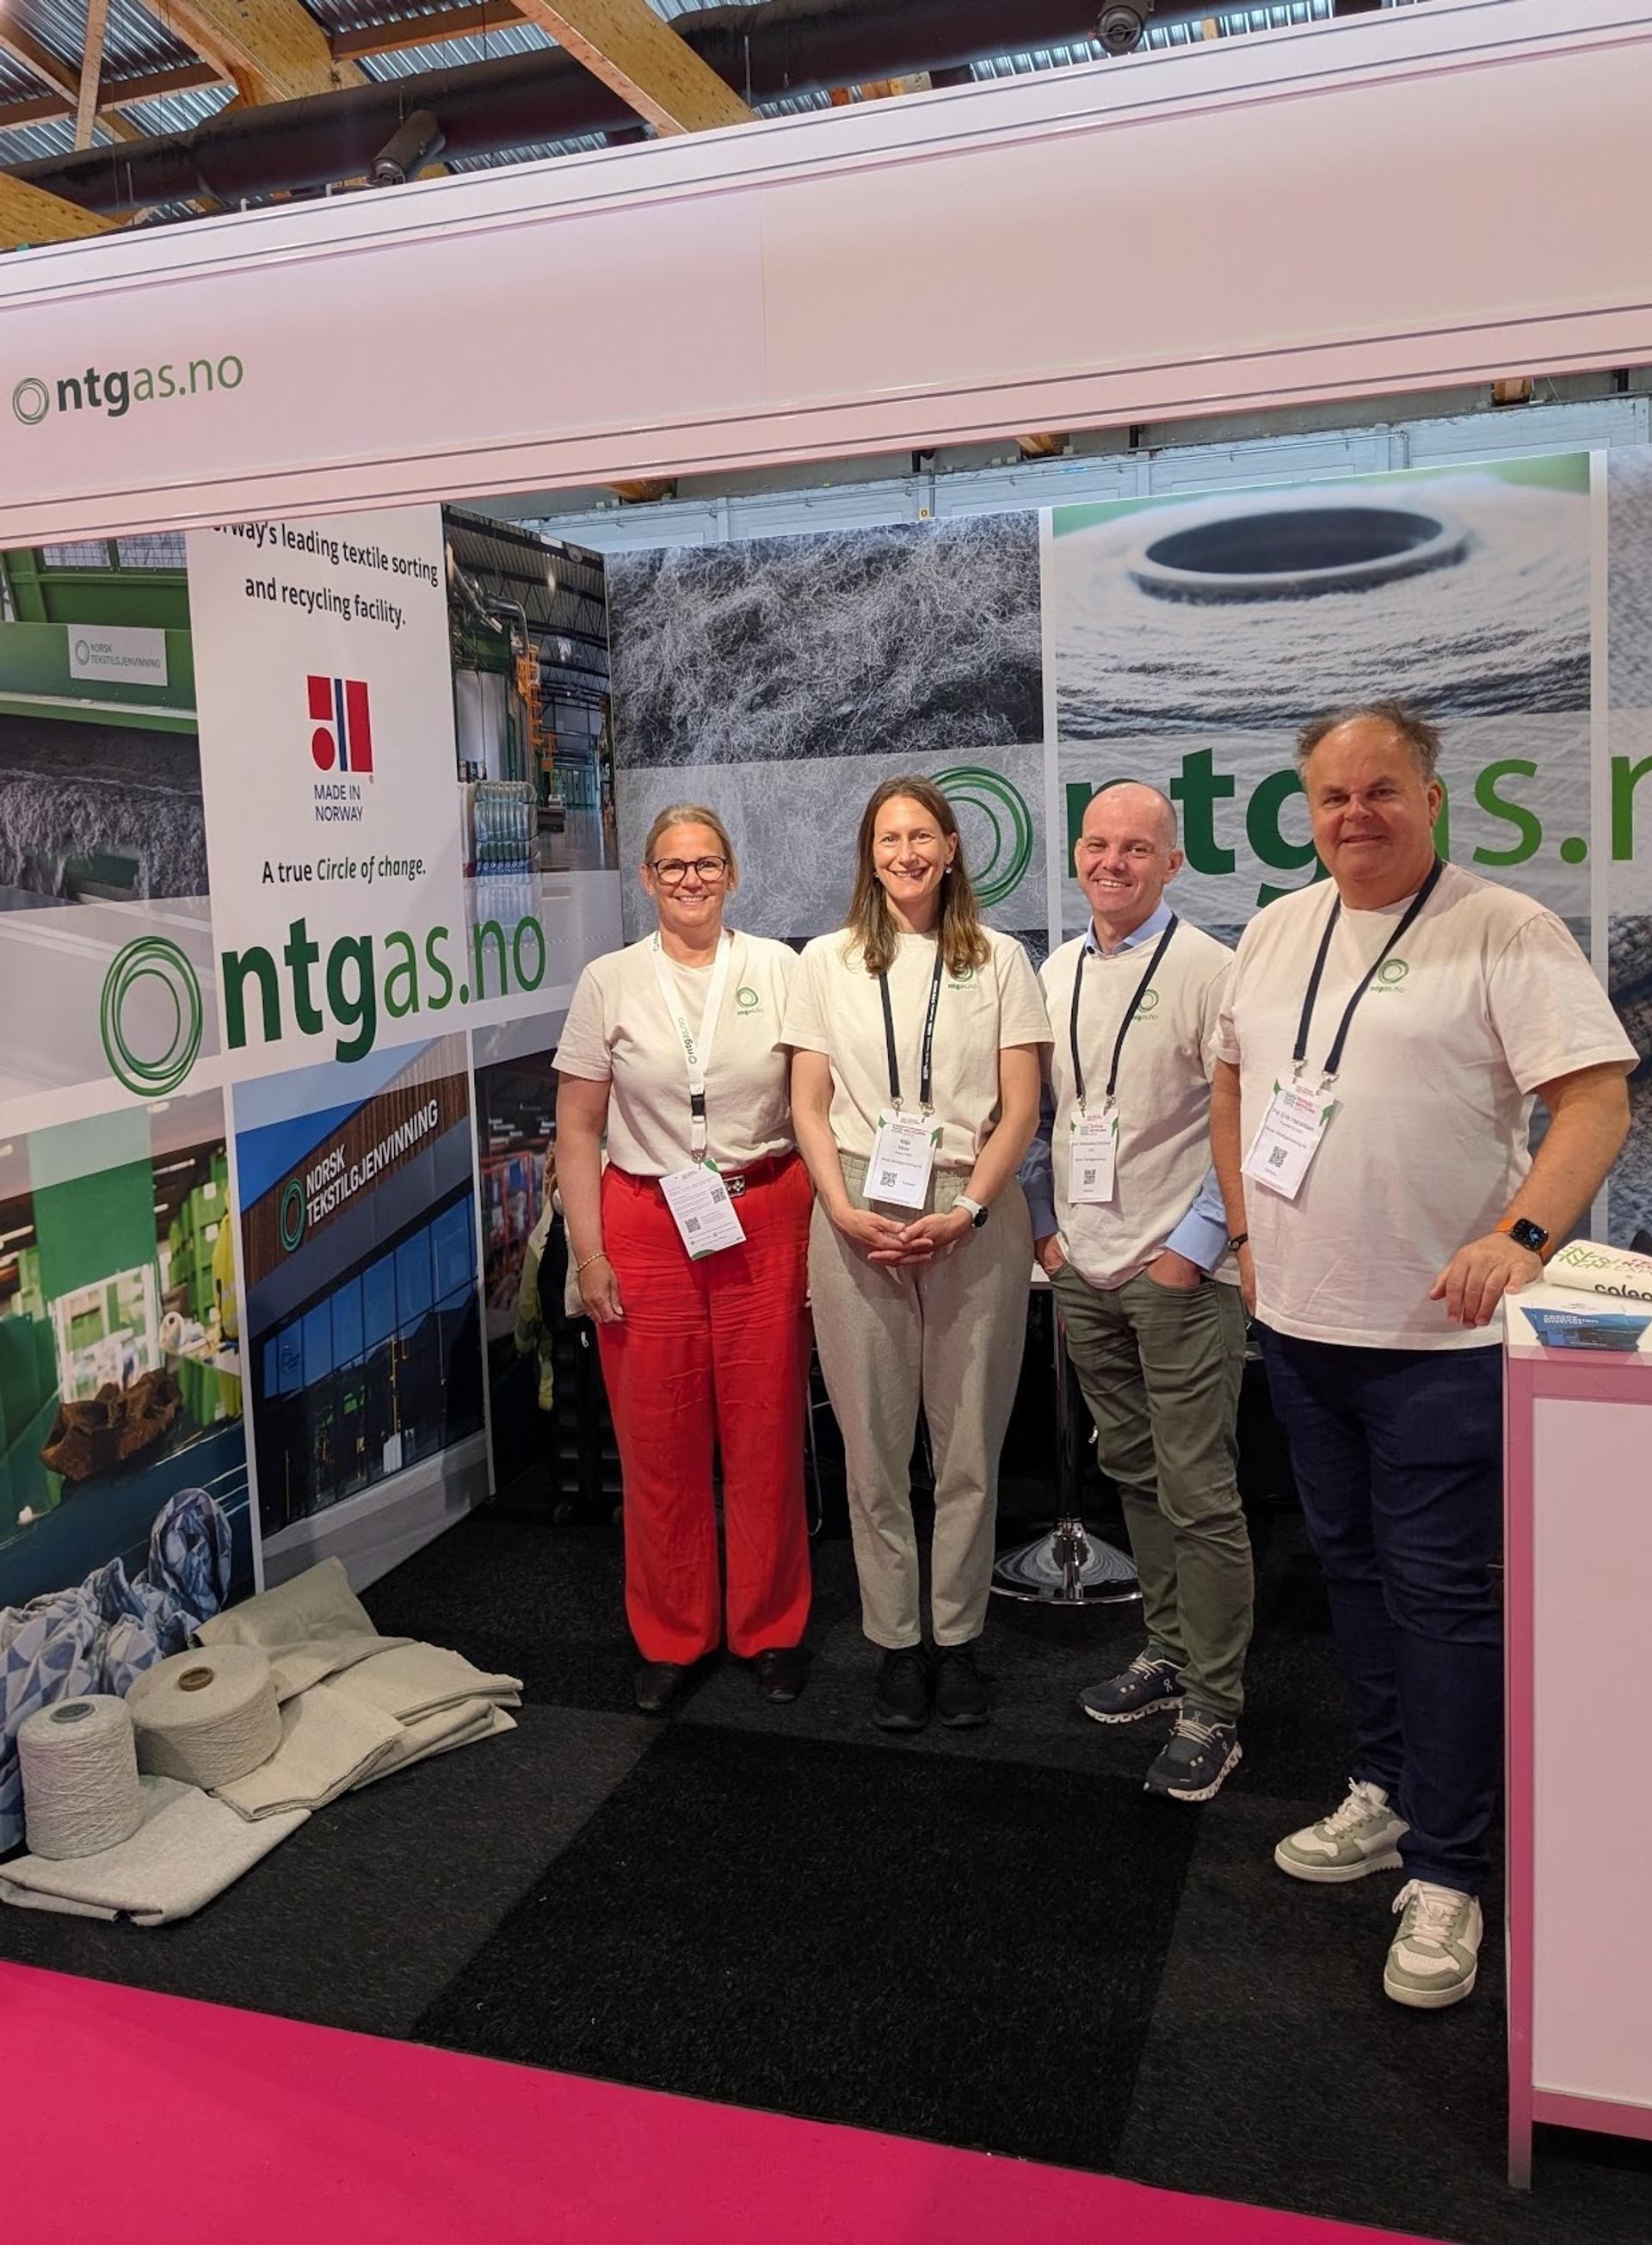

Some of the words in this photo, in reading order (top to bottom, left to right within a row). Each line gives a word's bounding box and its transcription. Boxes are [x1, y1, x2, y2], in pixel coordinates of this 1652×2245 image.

[56, 355, 243, 417] ntgas.no
[213, 522, 277, 548] way's
[281, 523, 339, 565] leading
[342, 541, 389, 571] textile
[391, 557, 439, 588] sorting
[245, 577, 276, 601] and
[281, 584, 351, 621] recycling
[354, 595, 406, 631] facility.
[314, 784, 346, 800] MADE
[349, 784, 361, 800] IN
[316, 805, 364, 822] NORWAY
[262, 860, 274, 885] A
[278, 862, 312, 883] true
[317, 857, 356, 880] Circle
[361, 855, 376, 885] of
[378, 855, 427, 881] change.
[221, 916, 546, 1064] ntgas.no
[306, 1099, 439, 1228] TEKSTILGJENVINNING
[306, 1144, 346, 1199] NORSK
